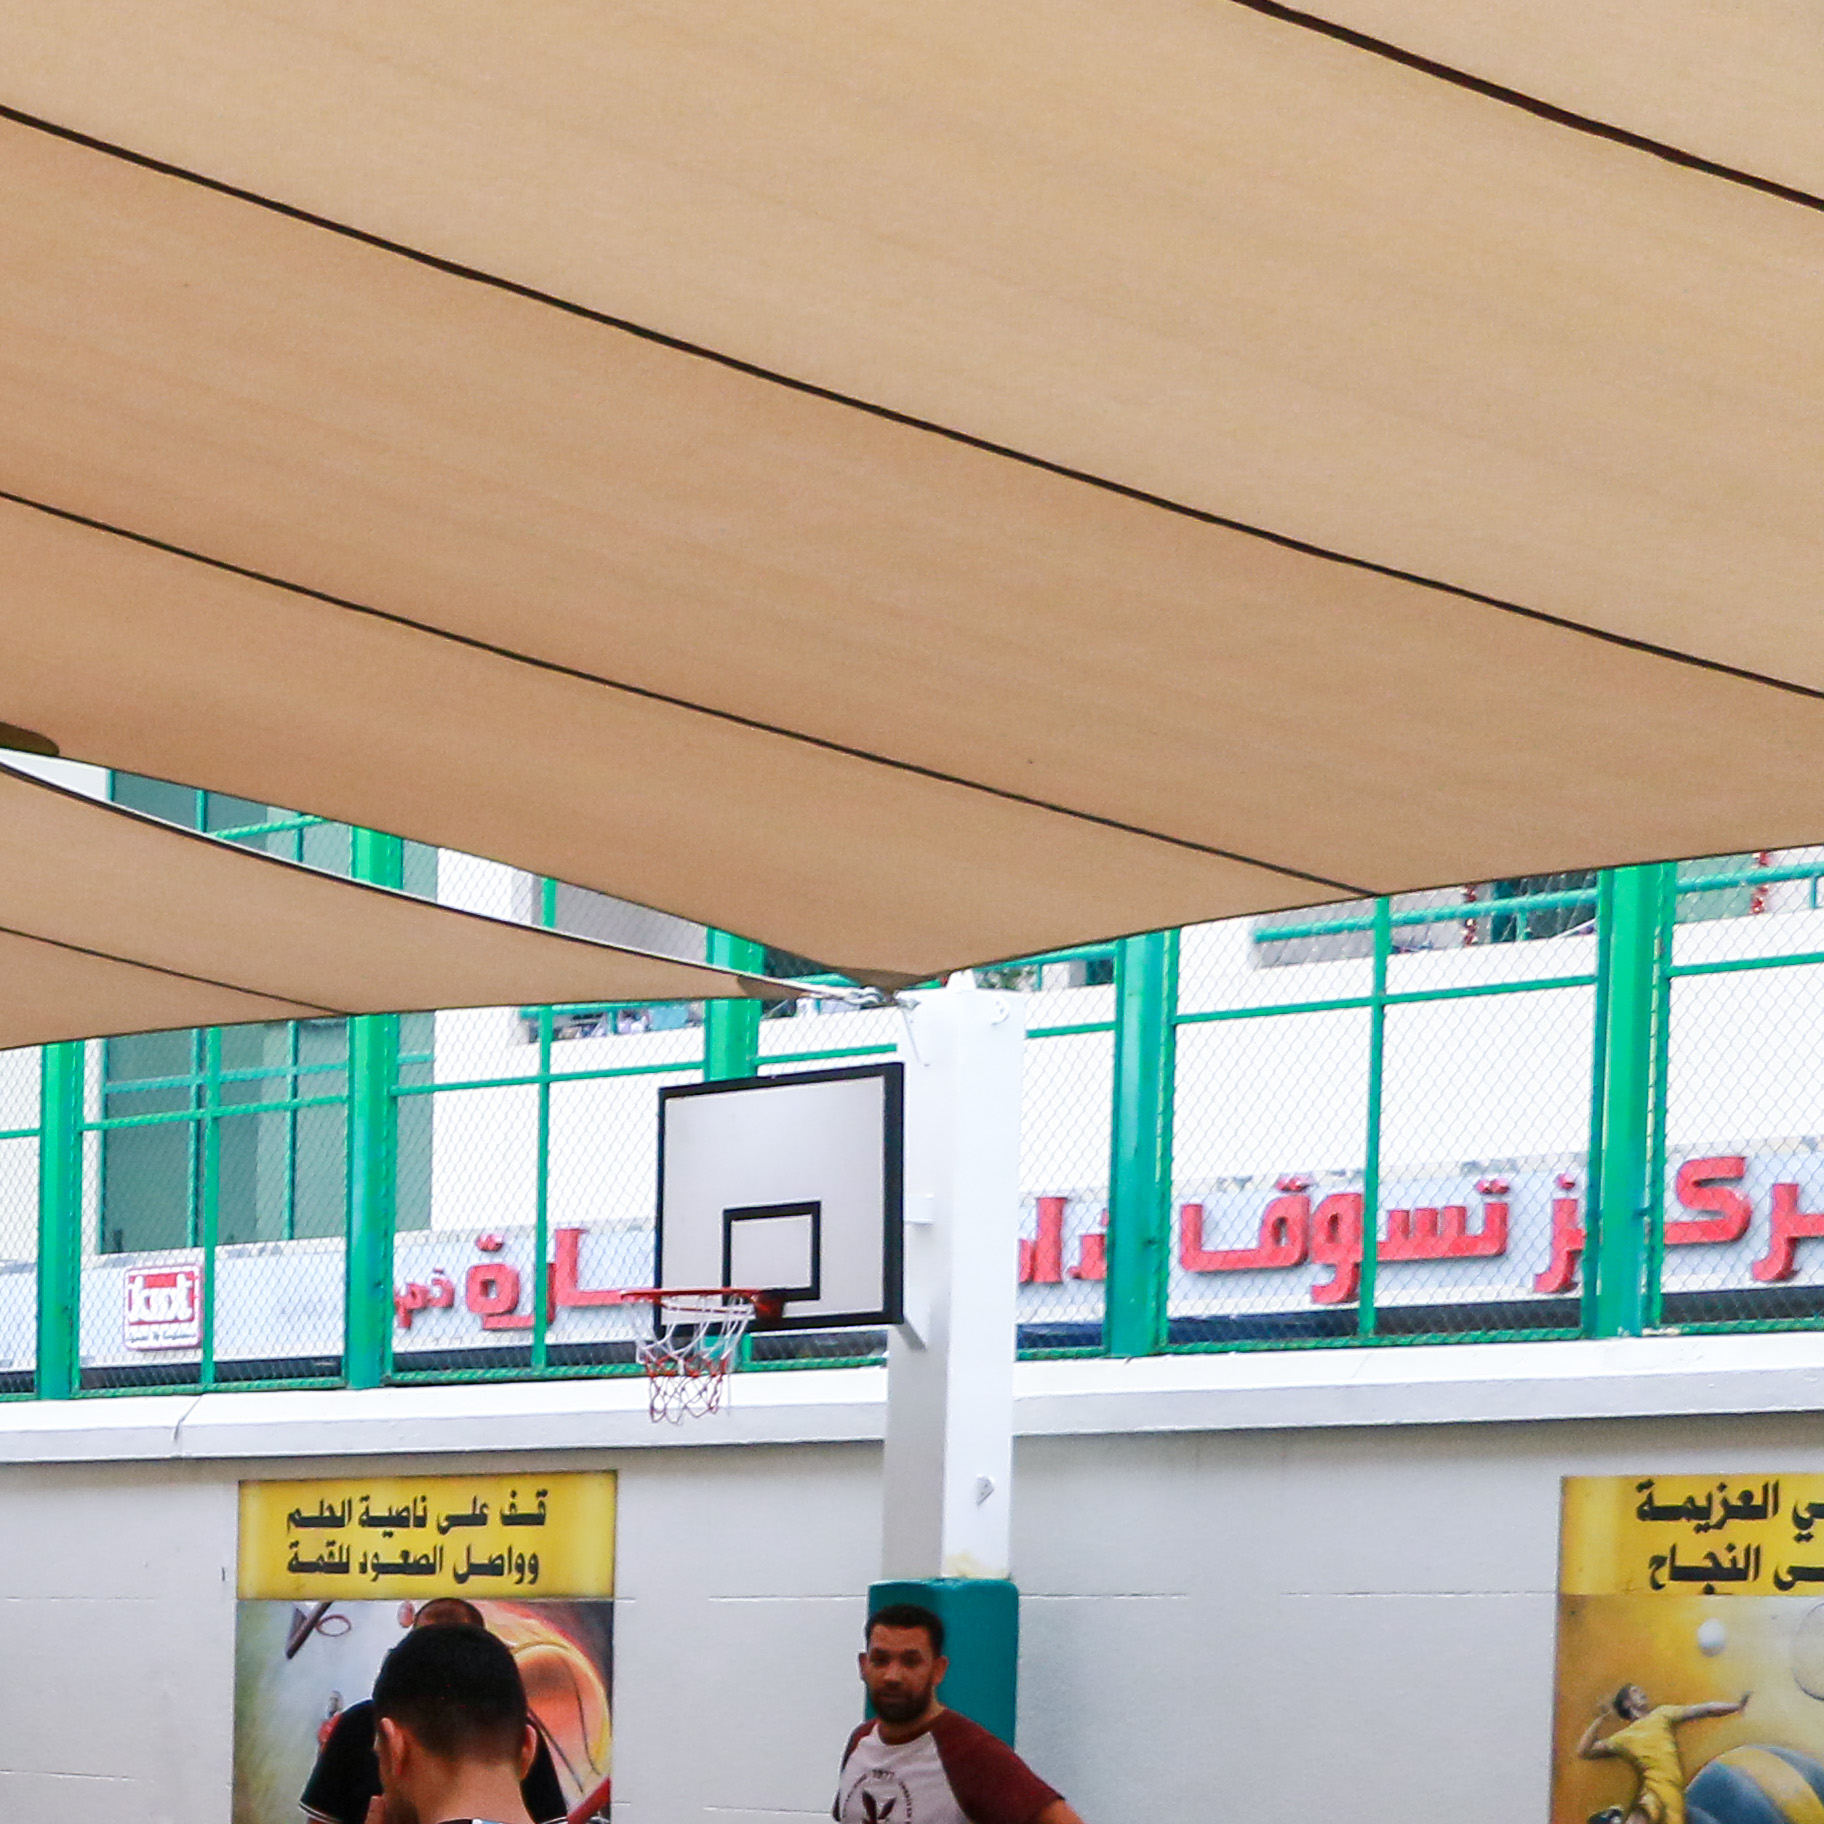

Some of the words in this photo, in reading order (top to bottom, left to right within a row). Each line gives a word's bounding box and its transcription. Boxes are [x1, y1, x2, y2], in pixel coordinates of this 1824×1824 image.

[286, 1496, 352, 1534] الحلم
[358, 1494, 428, 1538] ناصية
[437, 1495, 489, 1536] على
[500, 1488, 549, 1527] قف
[1635, 1479, 1780, 1534] العزيمة
[287, 1540, 351, 1574] للقمة
[358, 1544, 444, 1582] الصعود
[454, 1543, 540, 1584] وواصل
[1649, 1543, 1761, 1595] النجاح
